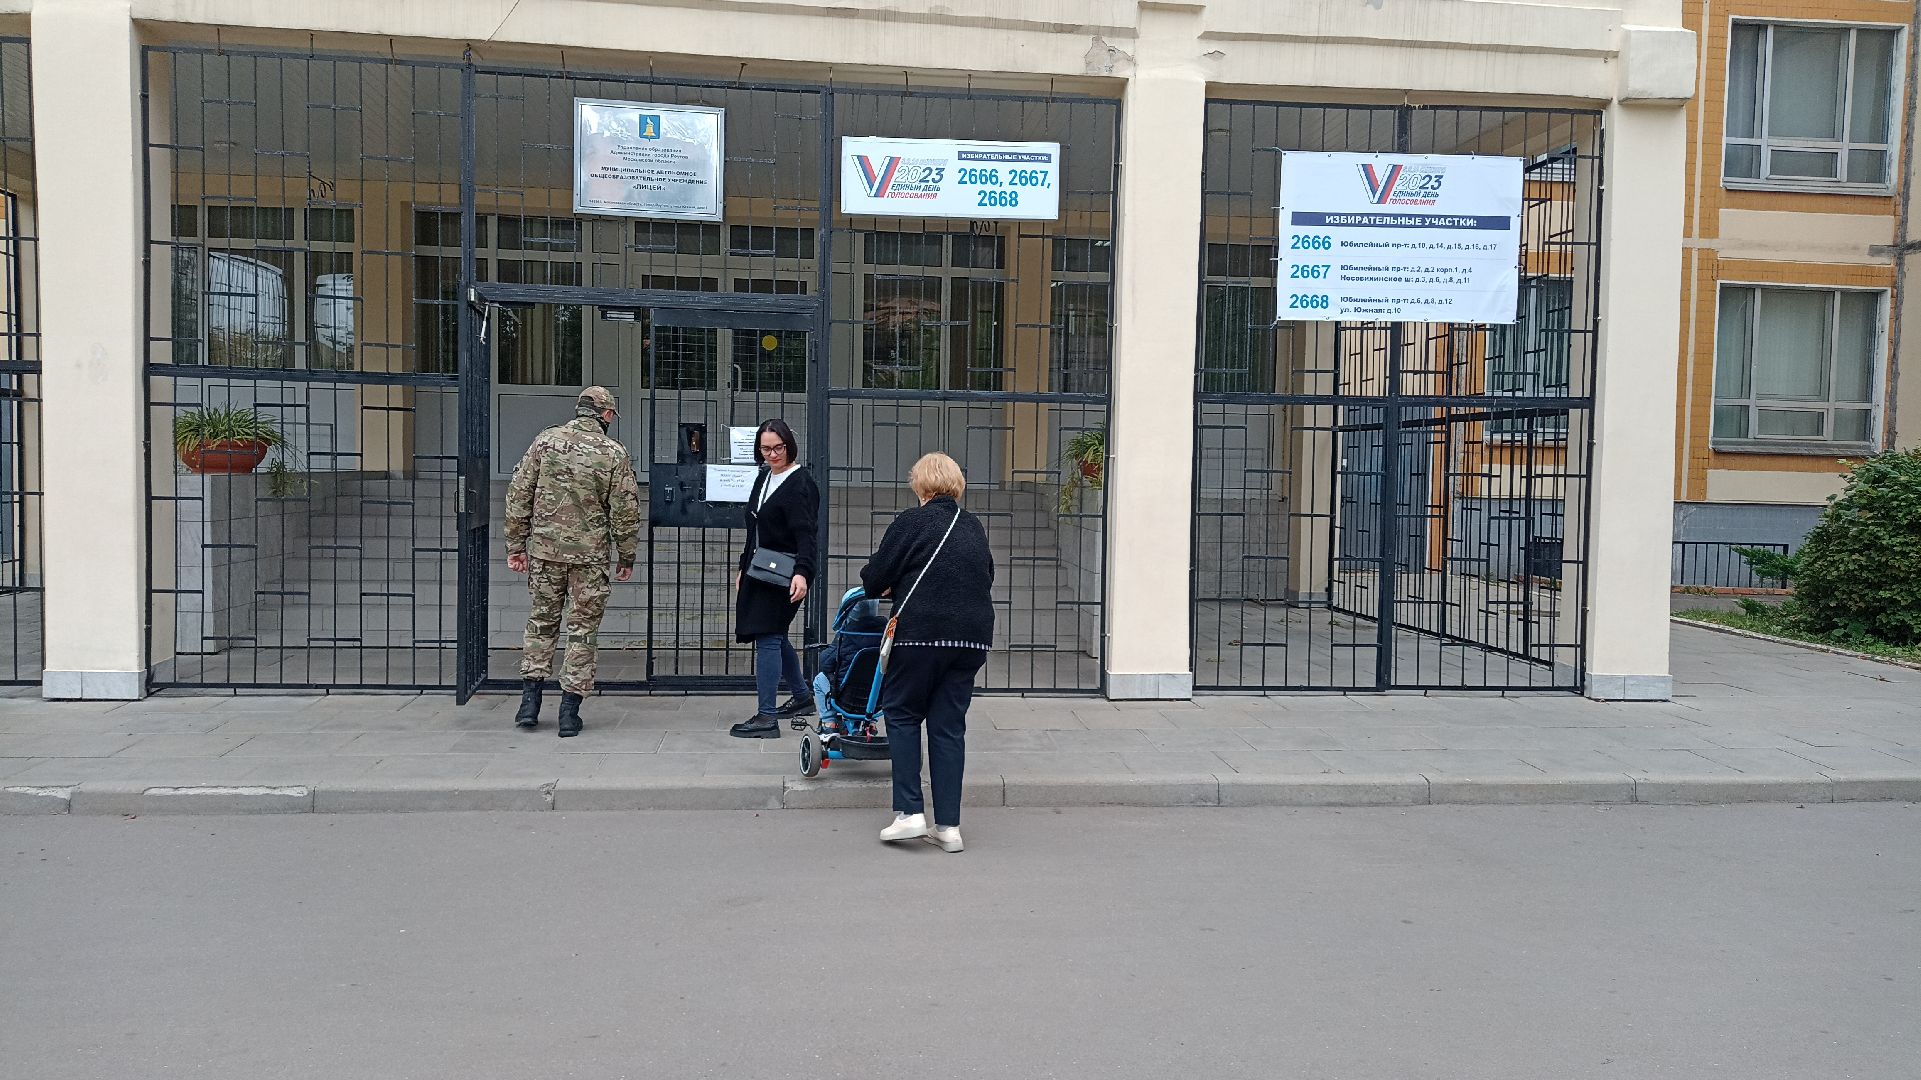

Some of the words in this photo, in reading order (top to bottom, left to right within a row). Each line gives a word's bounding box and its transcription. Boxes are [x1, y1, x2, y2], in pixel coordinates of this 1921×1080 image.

[893, 166, 945, 183] 2023
[957, 168, 1003, 187] 2666,
[1008, 169, 1051, 189] 2667,
[891, 183, 922, 191] ЕДИНЫЙ
[921, 184, 941, 192] ДЕНЬ
[1396, 174, 1444, 191] 2023
[886, 191, 938, 199] ГОЛОСОВАНИЯ
[977, 190, 1019, 207] 2668
[1389, 198, 1436, 206] ГОЛОСОВАНИЯ
[1393, 190, 1421, 198] ЕДИНЫЙ
[1421, 191, 1439, 199] ДЕНЬ
[1325, 215, 1422, 226] ИЗБИРАТЕЛЬНЫЕ
[1425, 217, 1477, 227] УЧАСТКИ:
[1290, 234, 1332, 250] 2666
[1340, 240, 1390, 248] Юбилейный
[1290, 264, 1331, 279] 2667
[1289, 294, 1329, 309] 2668
